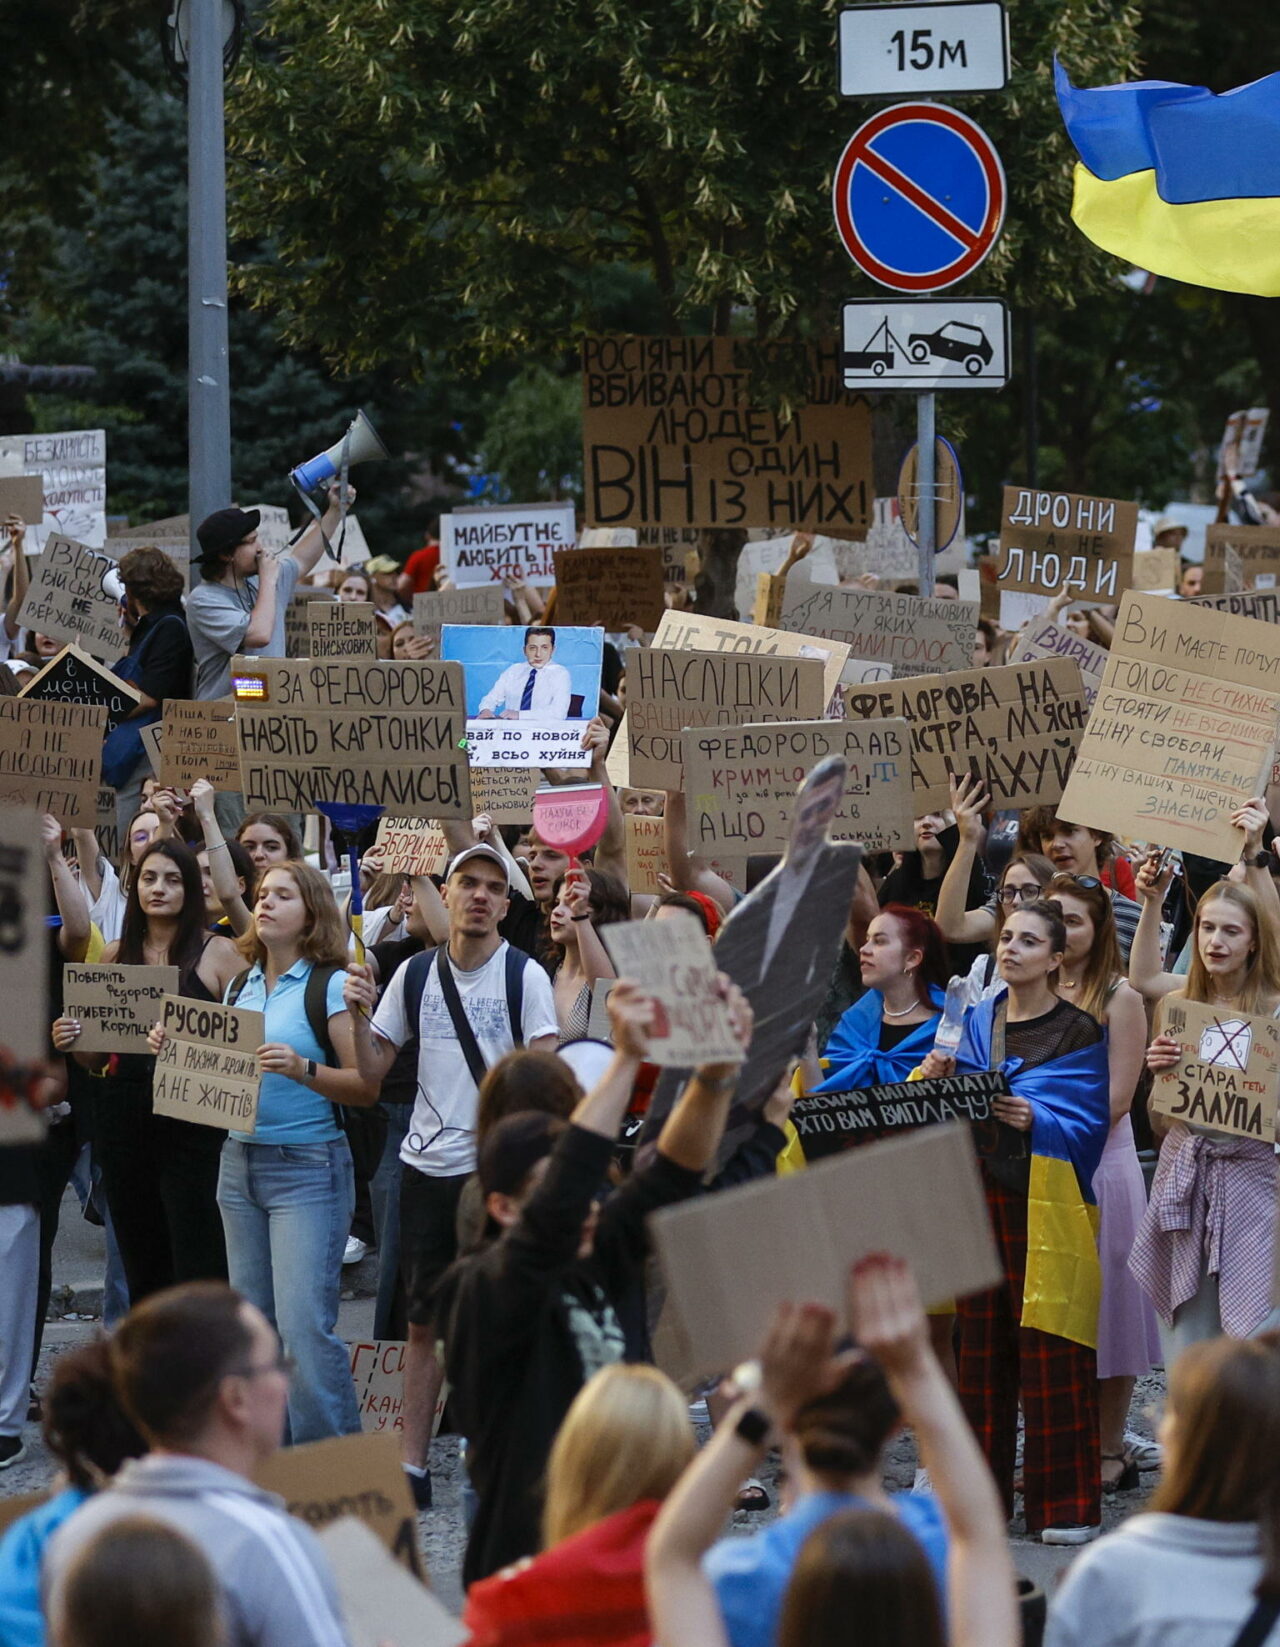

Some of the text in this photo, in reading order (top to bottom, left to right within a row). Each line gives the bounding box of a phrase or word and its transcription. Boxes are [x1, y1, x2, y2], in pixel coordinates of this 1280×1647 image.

[584, 338, 715, 373] РОСІЯНИ
[587, 373, 753, 409] ВБИВАЮТ
[727, 441, 841, 479] ОДИН
[591, 445, 869, 526] ВІН ІЗ НИХ!
[1009, 491, 1116, 534] ДРОНИ
[454, 522, 564, 545] МАЙБУТНЄ
[456, 545, 537, 568] ЛЮБИТЬ
[998, 547, 1118, 597] ЛЮДИ
[71, 597, 93, 614] НЕ
[873, 615, 916, 635] ЯКИХ
[277, 665, 455, 707] ЗА ФЕДОРОВА
[637, 652, 800, 710] НАСЛІДКИ
[1110, 659, 1179, 694] ГОЛОС
[850, 676, 1000, 722] ФЕДОРОВА
[1016, 668, 1061, 704] НА
[1102, 693, 1171, 723] СТОЯТИ
[0, 701, 99, 729] ДРОНАМИ
[20, 730, 71, 754] А НЕ
[240, 714, 455, 756] НАВІТЬ КАРТОНКИ
[466, 730, 581, 742] вай по новой
[699, 731, 903, 761] ФЕДОРОВ ДАВ
[1088, 717, 1136, 747] ЦІНУ
[491, 748, 530, 760] всьо
[538, 748, 588, 762] хуйня
[159, 1038, 178, 1066] ЗА
[874, 1070, 1004, 1102] НАПАМ'ЯТАТИ
[1184, 1064, 1237, 1092] СТАРА
[796, 1112, 837, 1136] ХТО
[838, 1107, 880, 1131] ВАМ
[1170, 1081, 1263, 1135] ЗАЛУПА
